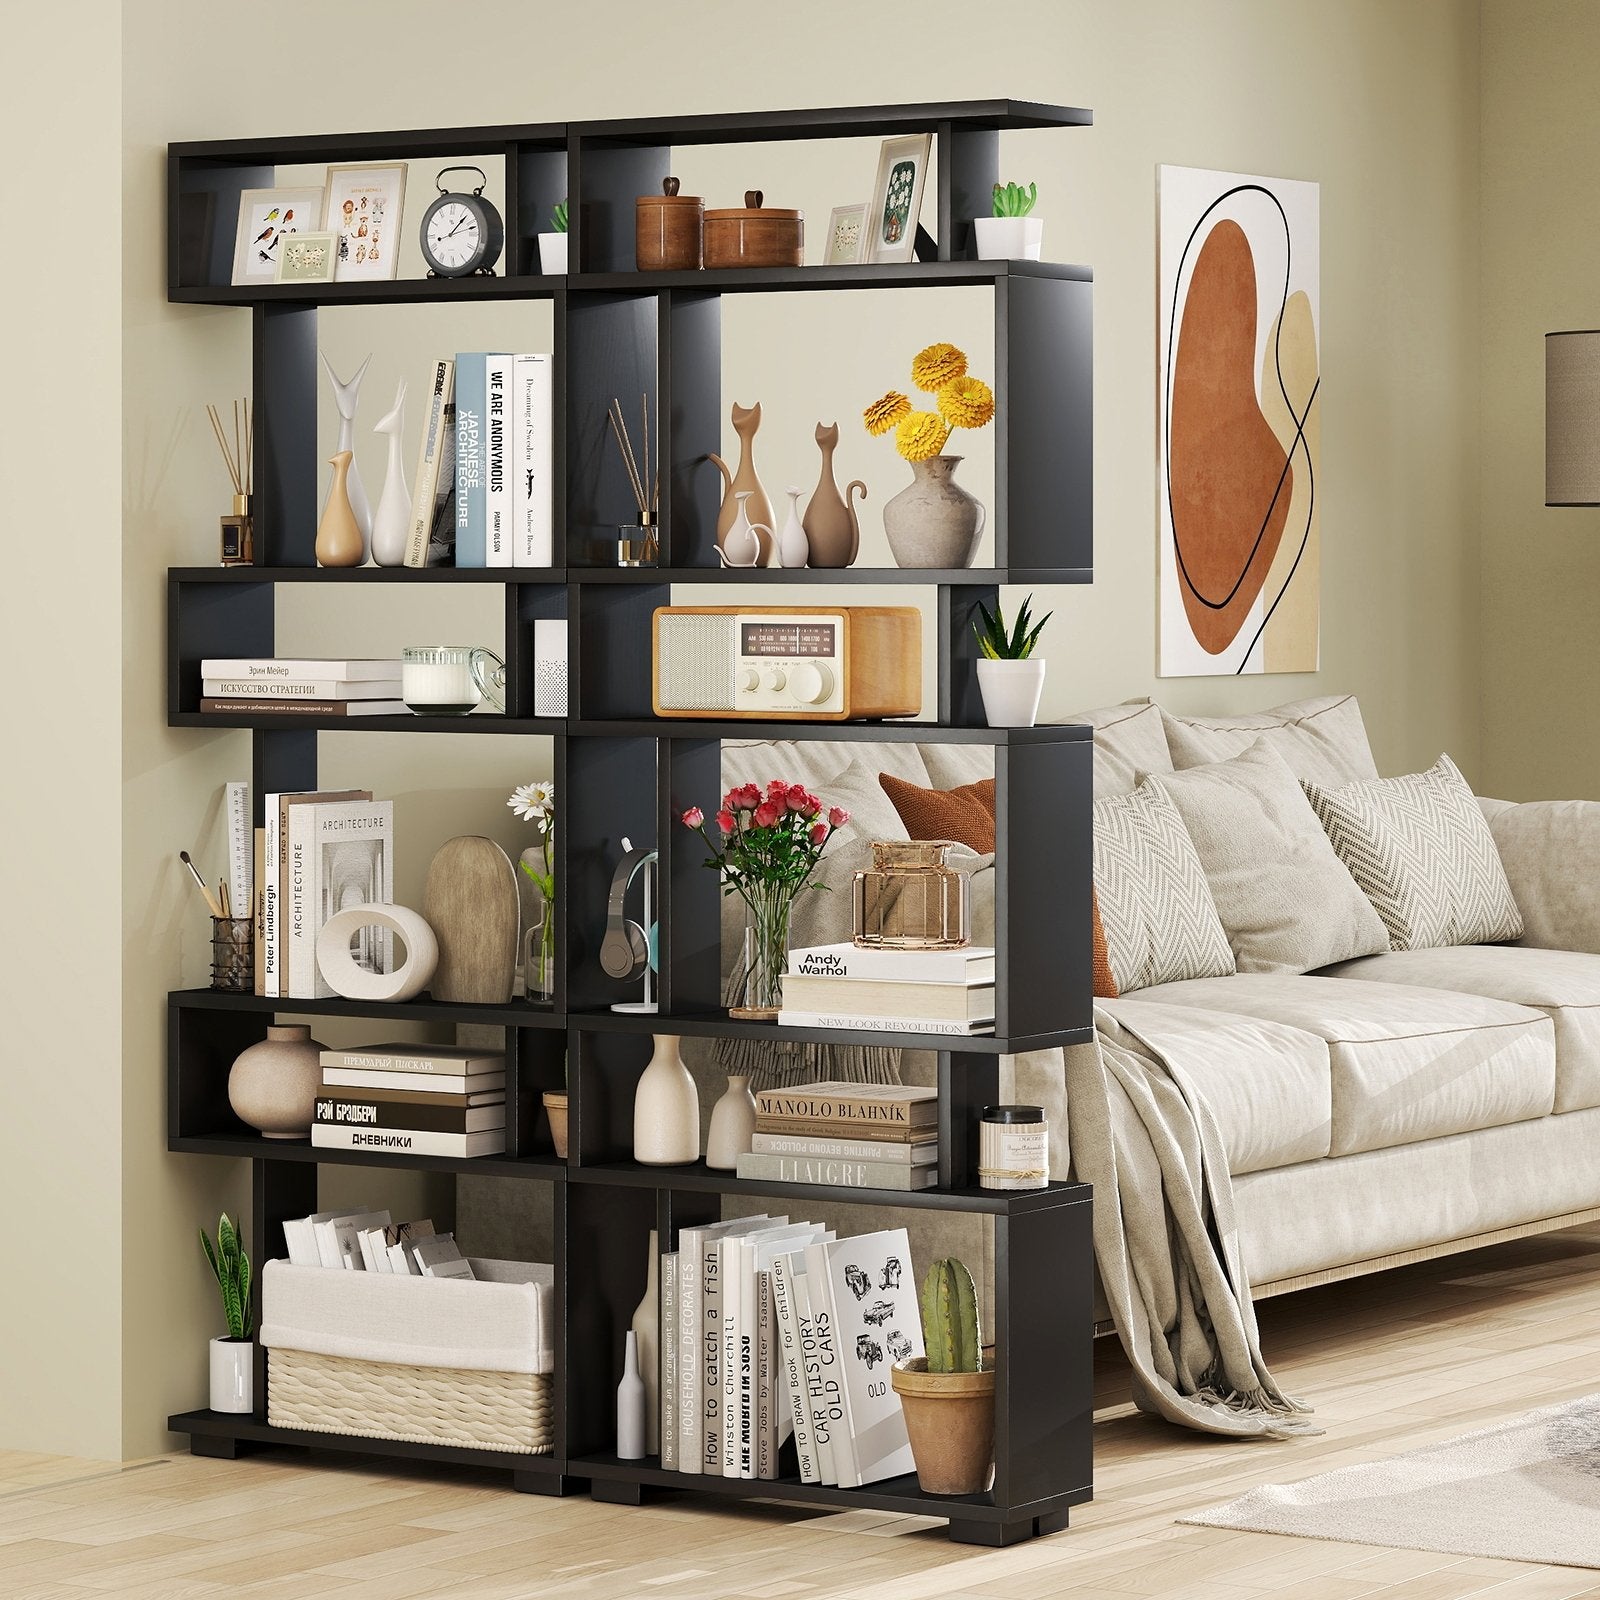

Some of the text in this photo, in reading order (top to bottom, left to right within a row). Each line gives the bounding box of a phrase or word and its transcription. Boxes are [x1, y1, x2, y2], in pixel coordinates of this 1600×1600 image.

[525, 378, 534, 418] Dreaming
[491, 372, 502, 492] WE ARE ANONYMOUS
[526, 419, 534, 428] of
[468, 410, 478, 488] JAPANESE
[458, 410, 468, 528] ARCHITECTURE
[479, 477, 486, 488] OF
[248, 666, 289, 676] Эрин Мейер
[220, 684, 315, 694] ИСКУССТВО СТРАТЕГИИ
[322, 818, 384, 830] ARCHITECTURE
[266, 884, 276, 941] Lindbergh
[804, 954, 842, 967] Andy
[798, 965, 847, 976] Warhol
[818, 1018, 963, 1033] NEW LOOK REVOLUTION
[344, 1056, 392, 1068] ПРЕМУДРЫЙ
[317, 1100, 376, 1123] РЭЙ БРЭДБЕРИ
[760, 1099, 905, 1121] MANOLO BLAHNÍK
[352, 1134, 412, 1148] ДНЕВНИКИ
[770, 1141, 806, 1153] POLLOCK
[809, 1142, 843, 1155] BEYOND
[844, 1145, 881, 1158] PAINTING
[780, 1160, 867, 1186] LIAIGRE
[774, 1260, 789, 1321] children
[665, 1312, 672, 1322] in
[666, 1327, 675, 1383] arrangement
[683, 1263, 694, 1436] HOUSEHOLD DECORATES
[705, 1253, 718, 1464] How to catch a fish
[817, 1312, 842, 1420] OLD CARS
[790, 1358, 799, 1388] Book
[798, 1316, 829, 1445] CAR HISTORY
[666, 1389, 673, 1399] an
[726, 1317, 734, 1466] Winston Churchill
[760, 1385, 769, 1398] by
[868, 1381, 886, 1398] OLD
[795, 1394, 804, 1425] DRAW
[666, 1430, 672, 1440] to
[798, 1432, 807, 1446] TO
[803, 1454, 812, 1478] HOW
